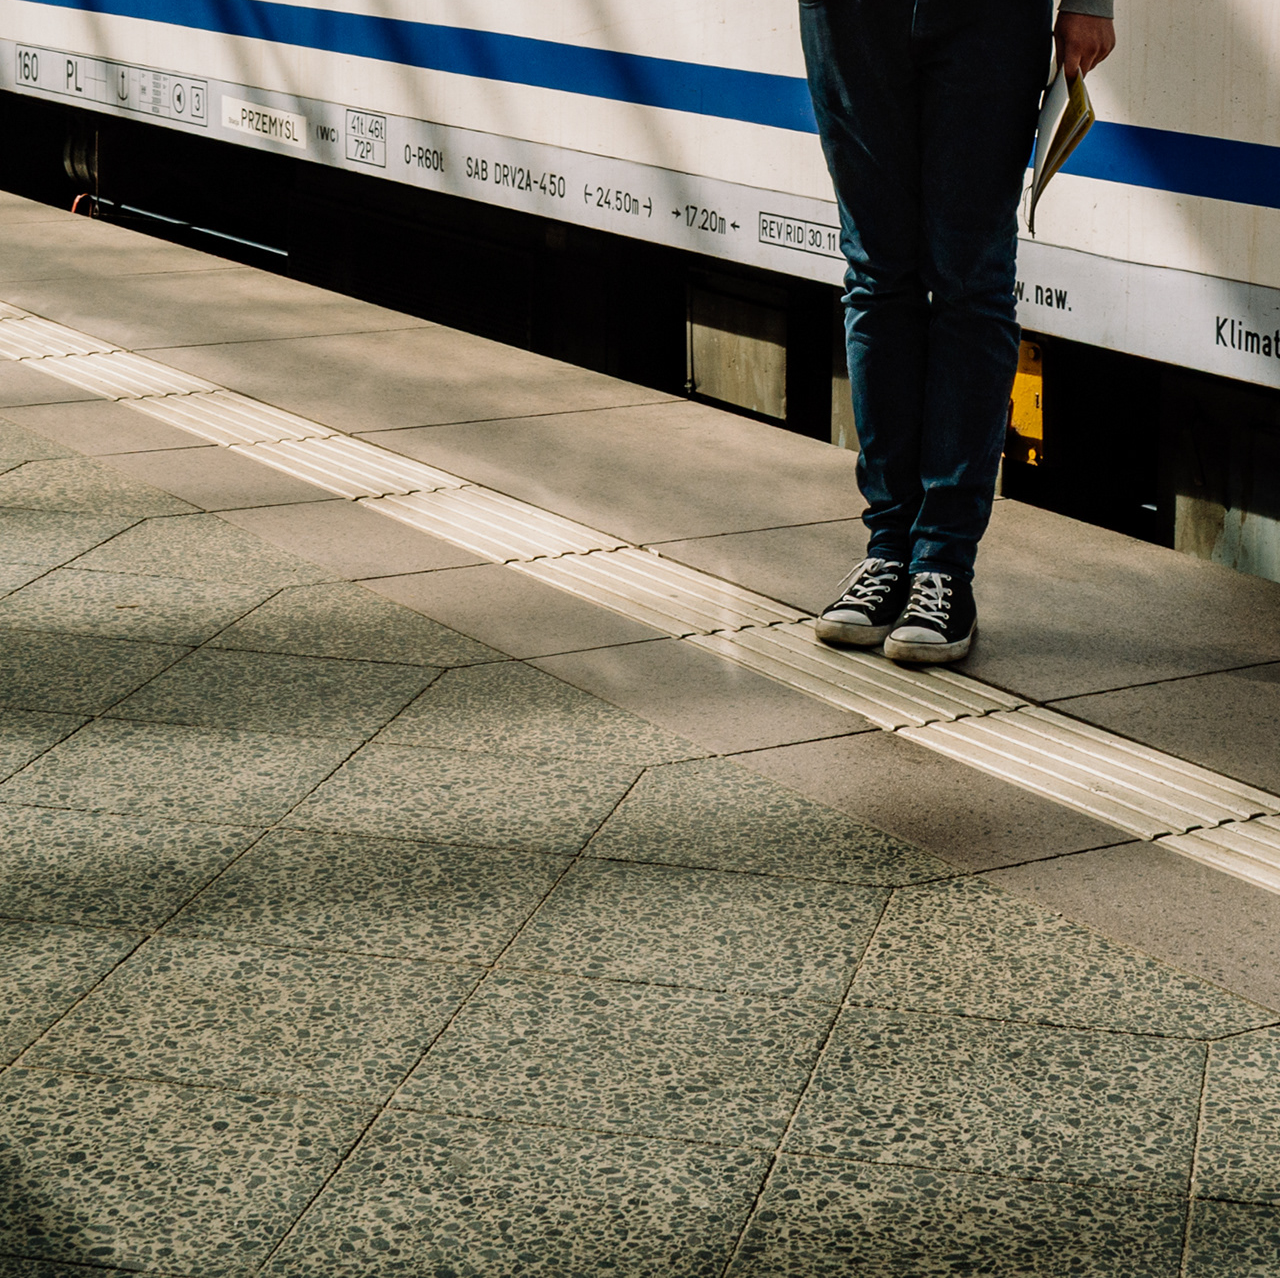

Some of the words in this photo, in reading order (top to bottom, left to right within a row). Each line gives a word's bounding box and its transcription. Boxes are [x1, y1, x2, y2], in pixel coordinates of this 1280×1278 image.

[19, 50, 39, 83] 160
[66, 59, 83, 93] PL
[193, 93, 201, 112] 3
[368, 119, 384, 140] 46t
[241, 107, 299, 143] PRZEMYŚL
[466, 156, 489, 181] SAB
[494, 162, 566, 199] DRV2A-450
[596, 186, 640, 216] 24.50m
[685, 204, 727, 235] 17.20m
[761, 218, 783, 240] REV
[785, 223, 804, 245] RID
[1035, 284, 1072, 312] naw.
